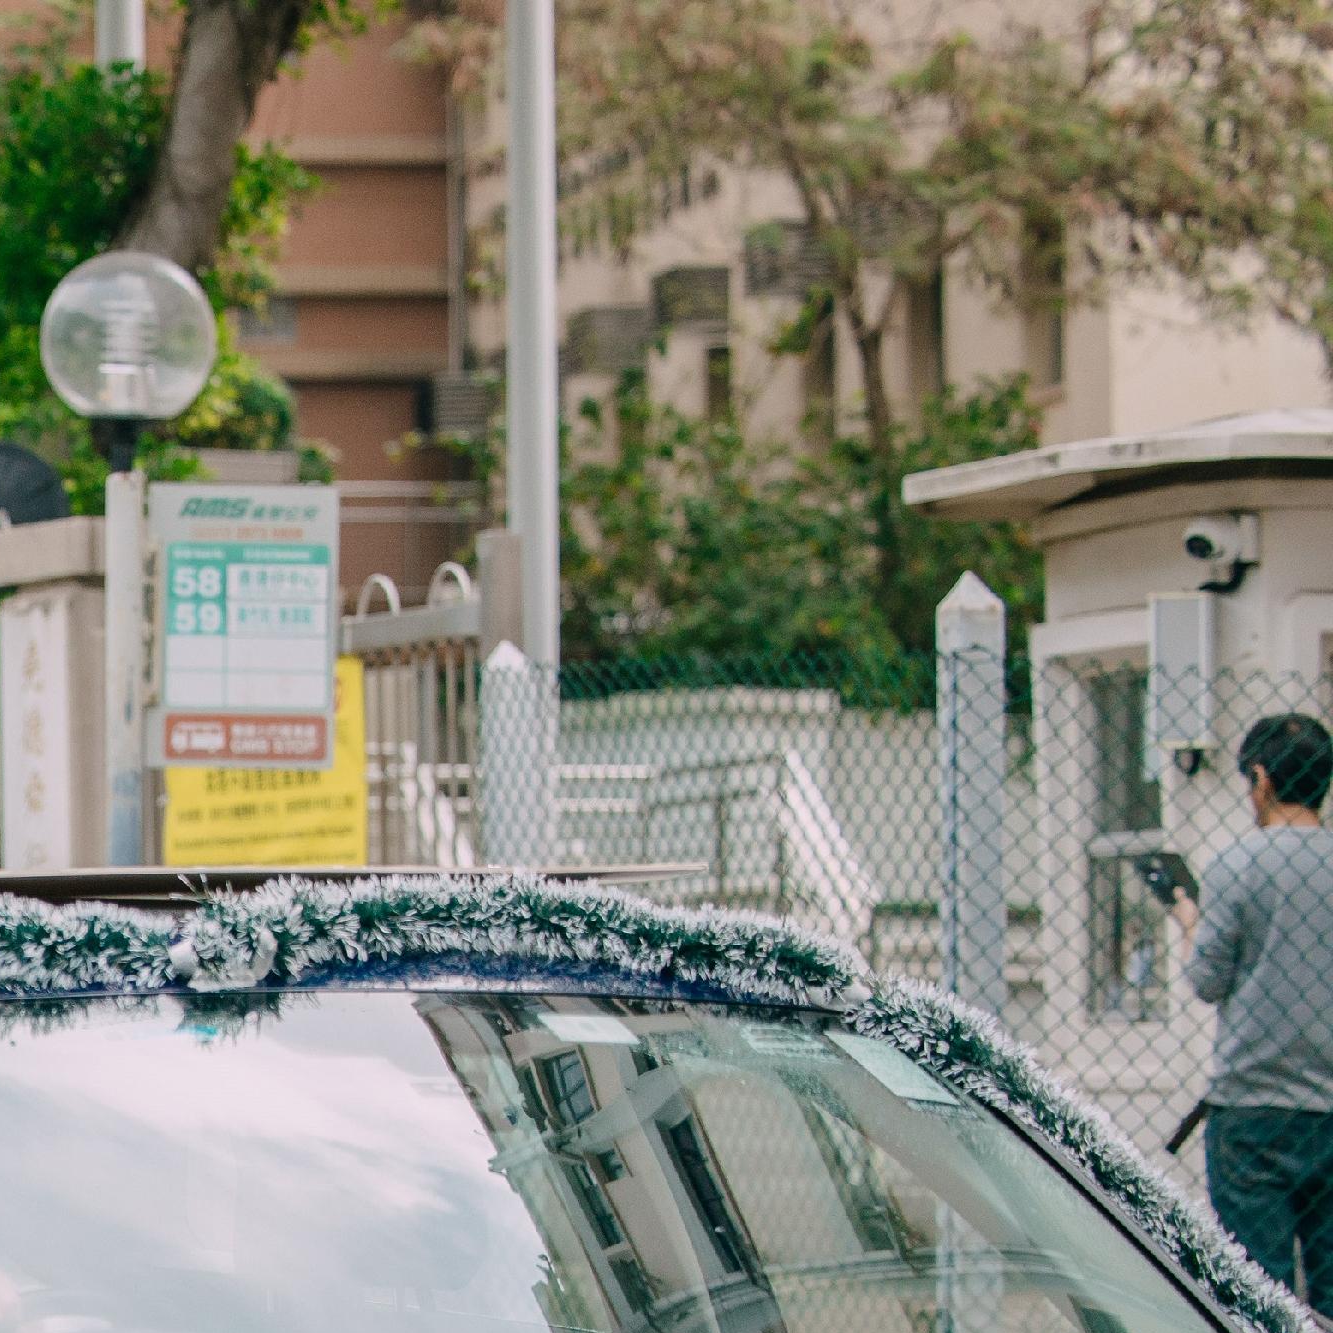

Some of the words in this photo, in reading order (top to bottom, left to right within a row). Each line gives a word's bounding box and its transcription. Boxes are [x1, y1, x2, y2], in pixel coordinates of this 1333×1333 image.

[180, 497, 252, 518] AMS
[172, 566, 222, 598] 58
[174, 601, 222, 632] 59
